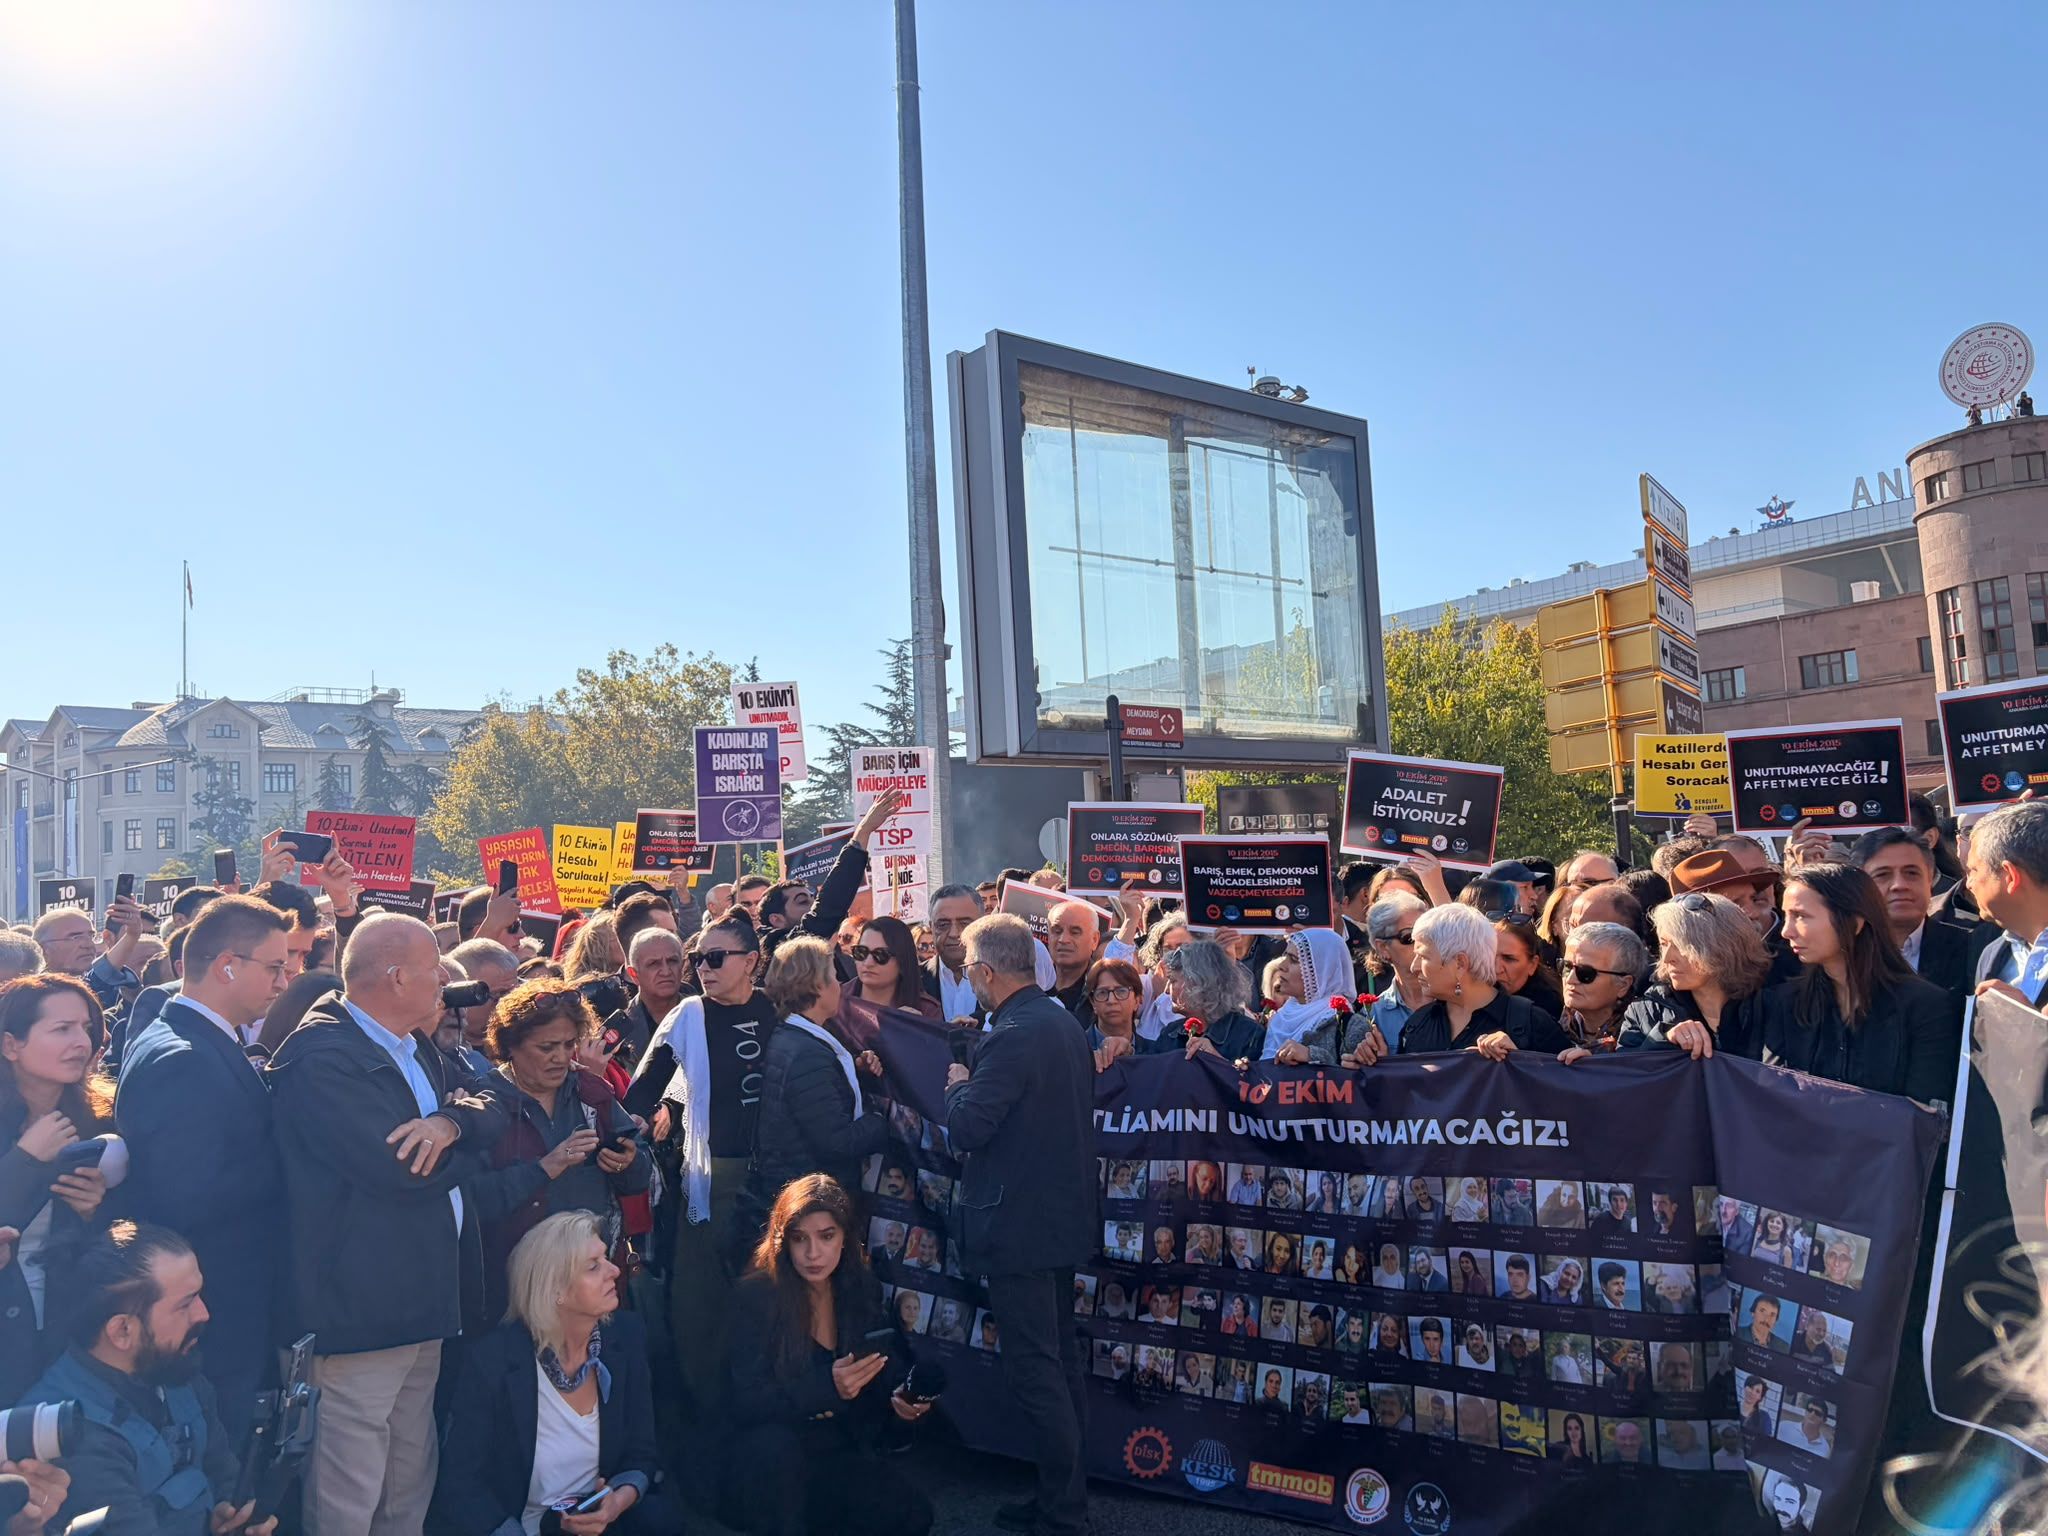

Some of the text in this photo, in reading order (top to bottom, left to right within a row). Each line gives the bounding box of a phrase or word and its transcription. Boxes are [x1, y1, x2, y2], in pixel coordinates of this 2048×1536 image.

[1851, 466, 1914, 510] AN
[1665, 594, 1685, 625] Ulus
[738, 685, 796, 709] 10 EKİM'İ
[2001, 695, 2042, 709] 10 EKİM
[749, 711, 789, 723] UNUTMADIK
[1126, 708, 1159, 719] DEMOKRASİ
[779, 721, 798, 734] CAĞIZ
[1126, 727, 1153, 736] MEYDANI
[707, 732, 768, 749] KADINLAR
[1793, 739, 1818, 750] EKİM
[1819, 739, 1842, 748] 2015
[712, 753, 764, 775] BARIŞTA
[863, 751, 921, 774] BARIŞ İÇİN
[1643, 759, 1695, 770] Hesabı
[1744, 760, 1876, 778] UNUTTURMAYACAĞIZ
[715, 775, 764, 793] ISRARCI
[857, 775, 927, 793] MÜCADELEYE
[1396, 770, 1448, 783] 10 EKİM 2015
[1381, 787, 1448, 806] ADALET
[316, 818, 332, 831] 10
[1120, 814, 1139, 822] EKİM
[559, 834, 572, 848] 10
[649, 830, 678, 838] ONLARA
[875, 828, 914, 846] TSP
[1090, 832, 1129, 841] ONLARA
[1401, 834, 1430, 845] tmmob
[485, 836, 536, 856] YAŞASIN
[1095, 843, 1177, 854] EMEĞİN, BARIŞIN,
[1238, 848, 1259, 857] EKİM
[1260, 849, 1279, 857] 2015
[339, 849, 404, 870] ÜTLEN!
[558, 851, 598, 867] Hesabı
[1082, 854, 1181, 865] DEMOKRASİNİN ÜLKE
[351, 870, 369, 880] adın
[556, 866, 610, 886] Sorulacak!
[1193, 865, 1319, 877] BARIŞ, EMEK, DEMOKRASİ
[1210, 876, 1301, 887] MÜCADELESİNDEN
[59, 885, 76, 900] 10
[163, 884, 178, 900] 10
[563, 896, 595, 904] Hareketi
[1238, 1071, 1353, 1105] 10 EKİM
[1228, 1109, 1569, 1147] UNUTTURMAYACAĞIZ!
[1134, 1444, 1161, 1461] DİSK
[1180, 1457, 1237, 1483] KESK
[1250, 1464, 1332, 1498] tmmob
